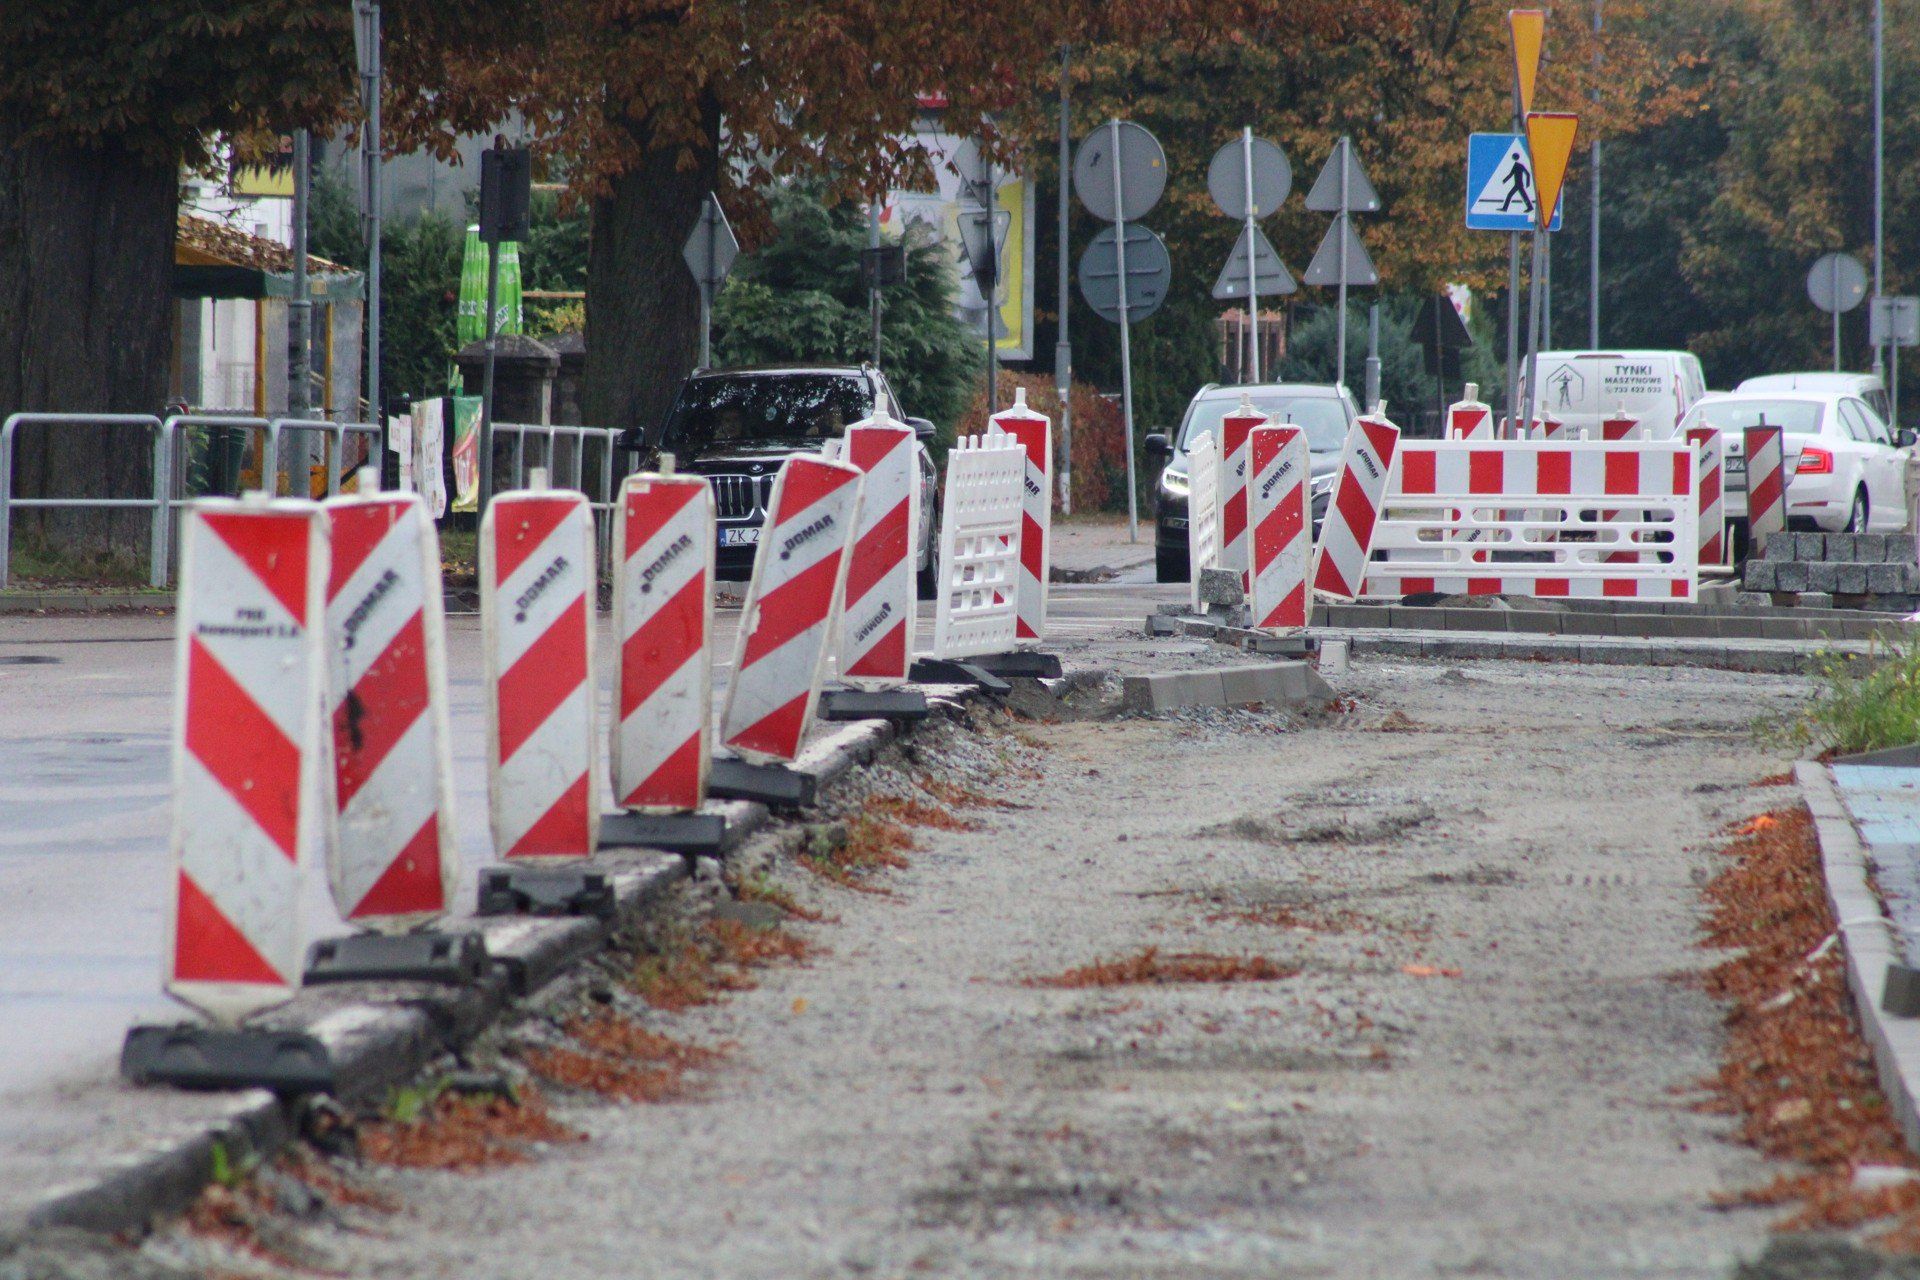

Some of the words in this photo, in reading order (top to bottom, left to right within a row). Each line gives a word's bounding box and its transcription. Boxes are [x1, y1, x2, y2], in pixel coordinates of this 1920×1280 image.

[1615, 365, 1652, 375] TYNKI
[1262, 460, 1292, 492] DOMAR
[1361, 451, 1380, 479] DOMAR
[729, 529, 746, 543] ZK
[784, 514, 834, 551] DOMAR
[642, 534, 693, 582] DOMAR
[515, 555, 569, 609] DOMAR
[343, 569, 399, 633] DOMAR
[855, 609, 889, 642] DOMAR
